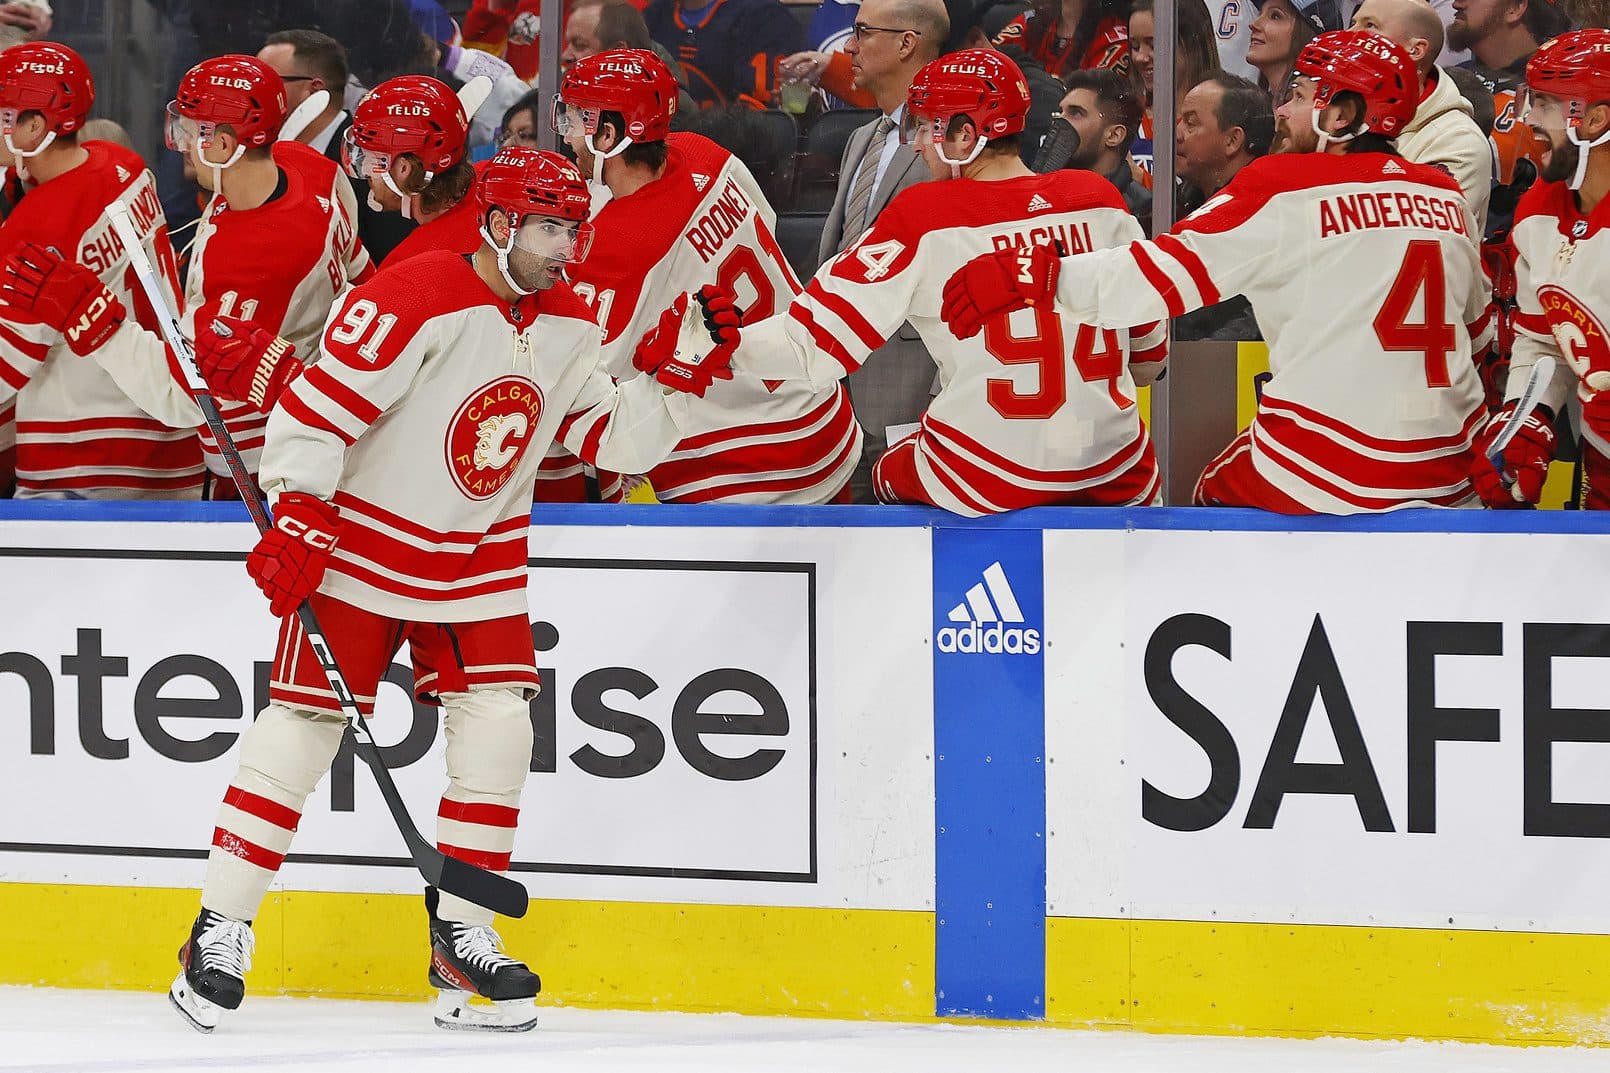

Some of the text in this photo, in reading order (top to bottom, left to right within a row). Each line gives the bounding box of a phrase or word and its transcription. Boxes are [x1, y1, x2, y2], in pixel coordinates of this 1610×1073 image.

[210, 75, 252, 91] TELUS
[942, 64, 987, 75] TELUS
[387, 104, 431, 117] TELUS
[492, 155, 526, 168] TELUS
[565, 194, 588, 203] CCM
[685, 176, 750, 263] ROONEY
[67, 285, 115, 342] CCM
[217, 290, 259, 322] 11
[1373, 239, 1456, 388] 4
[331, 298, 398, 364] 91
[984, 306, 1135, 419] 94
[467, 385, 540, 428] CALGARY
[456, 454, 520, 493] FLAMES
[277, 515, 339, 551] CC
[936, 620, 1041, 655] adidas
[307, 633, 372, 743] CCM
[1142, 612, 1610, 838] SAFE
[434, 956, 460, 985] CCM
